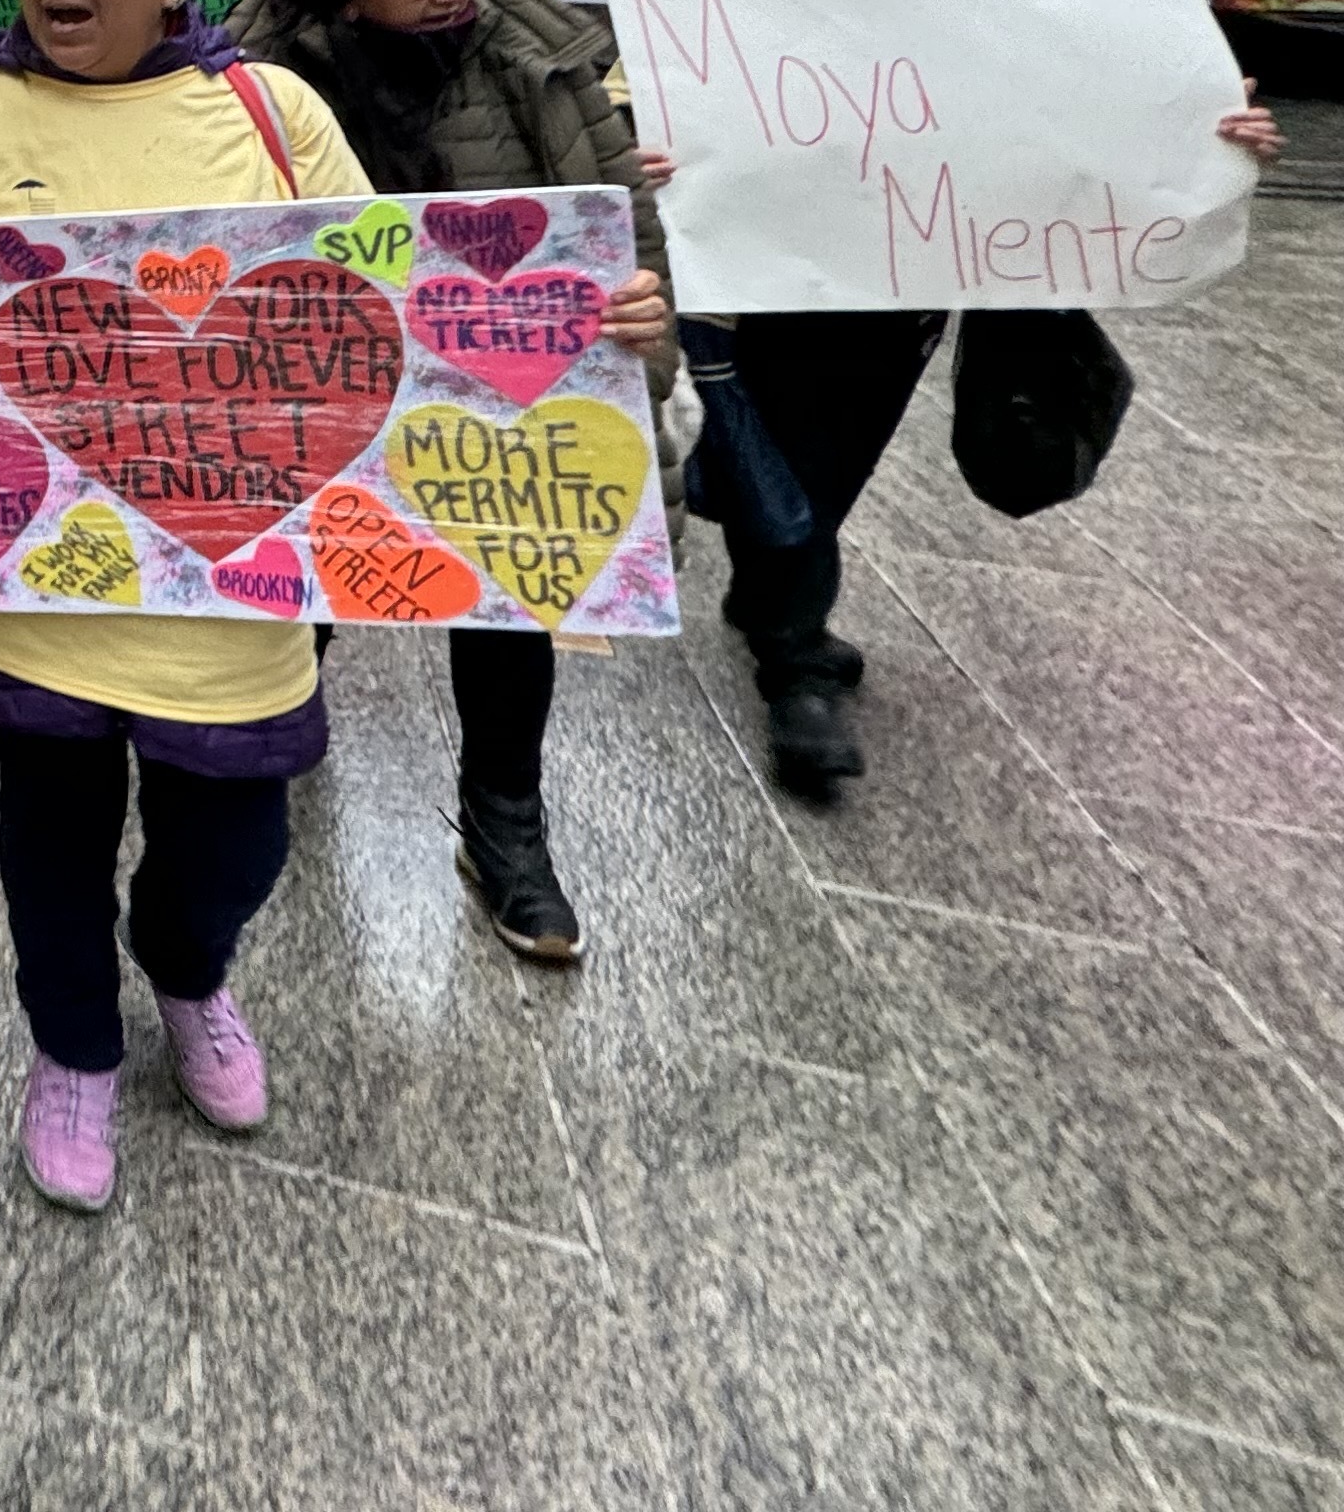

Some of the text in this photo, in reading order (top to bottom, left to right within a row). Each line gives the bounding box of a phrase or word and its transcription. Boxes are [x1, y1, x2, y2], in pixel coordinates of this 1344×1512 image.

[324, 222, 412, 266] SVP
[883, 161, 1191, 296] Miente
[12, 272, 377, 338] NEW YORK
[139, 261, 223, 297] BRONX
[416, 279, 600, 317] NO MORE
[426, 317, 586, 355] TICKETS
[15, 335, 404, 396] LOVE FOREVER
[57, 394, 326, 462] STREET
[403, 417, 590, 481] MORE
[99, 452, 309, 508] VENDORS
[412, 477, 627, 536] PERMITS
[39, 520, 91, 572] WORK
[326, 492, 449, 591] OPEN
[474, 531, 583, 576] FOR
[50, 562, 87, 596] FOR
[81, 545, 139, 600] FAMILY
[216, 567, 313, 608] BROOKLYN
[311, 524, 433, 620] STREETS
[516, 573, 575, 610] US
